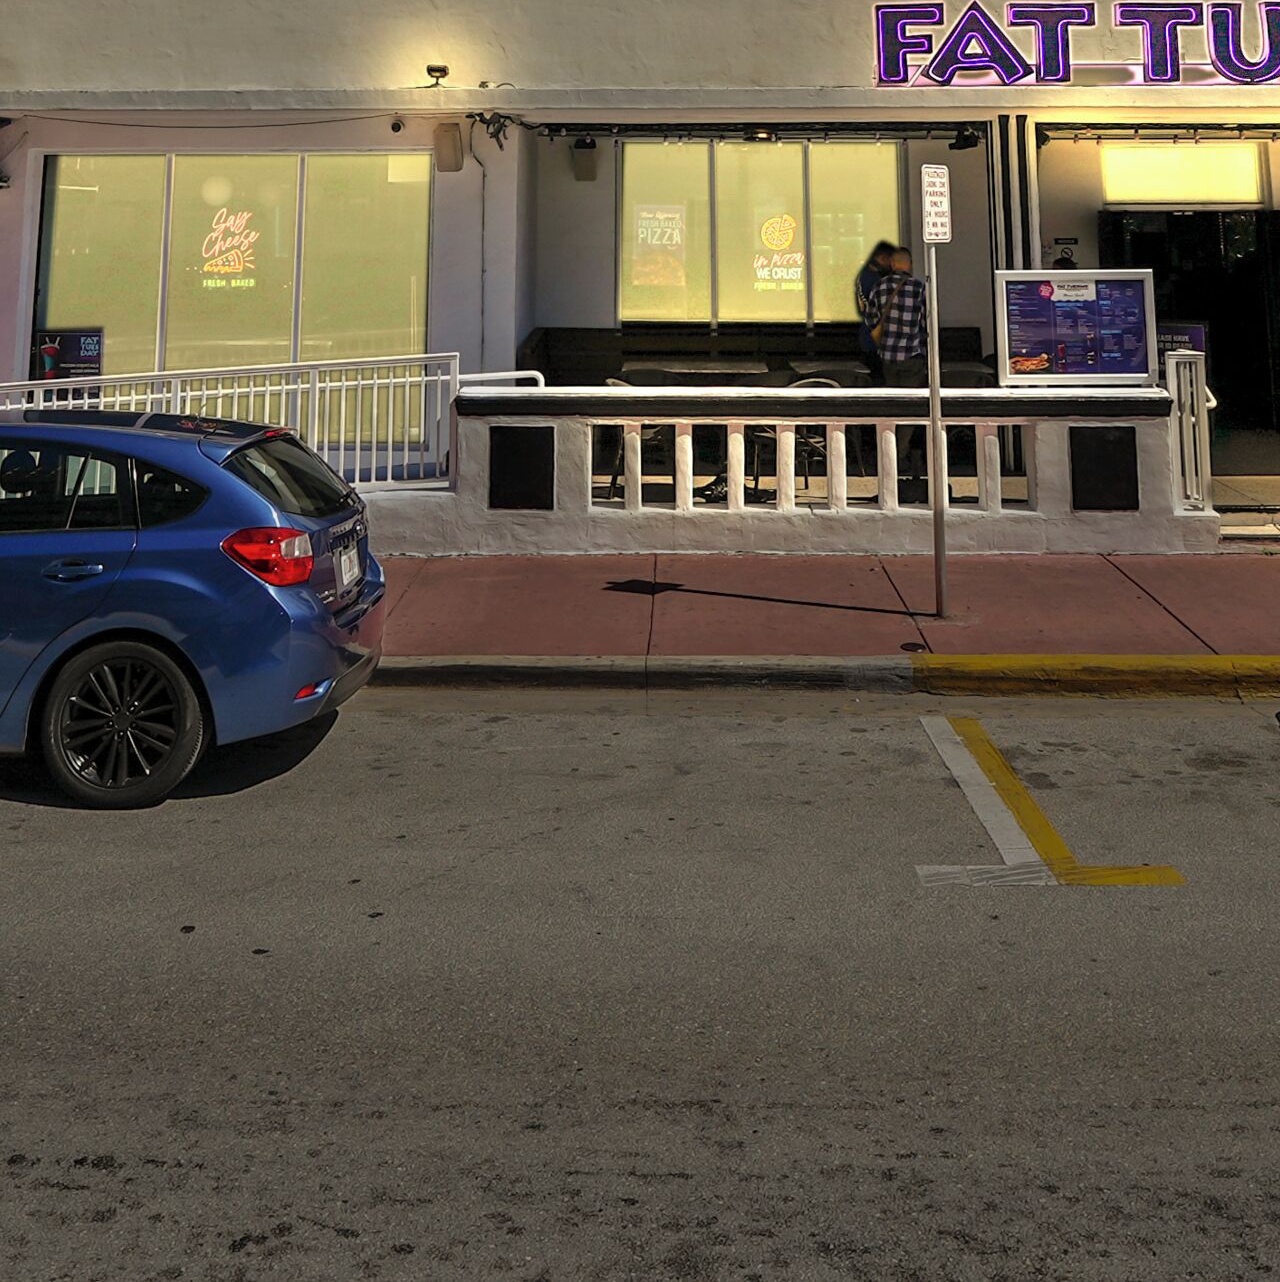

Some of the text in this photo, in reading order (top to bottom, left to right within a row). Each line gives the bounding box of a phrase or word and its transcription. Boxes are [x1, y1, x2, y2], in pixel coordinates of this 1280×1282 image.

[874, 0, 1096, 86] FAT
[211, 207, 253, 234] Say
[202, 229, 260, 258] Cheese
[638, 228, 681, 245] PIZZA
[756, 267, 803, 279] WE CRUST
